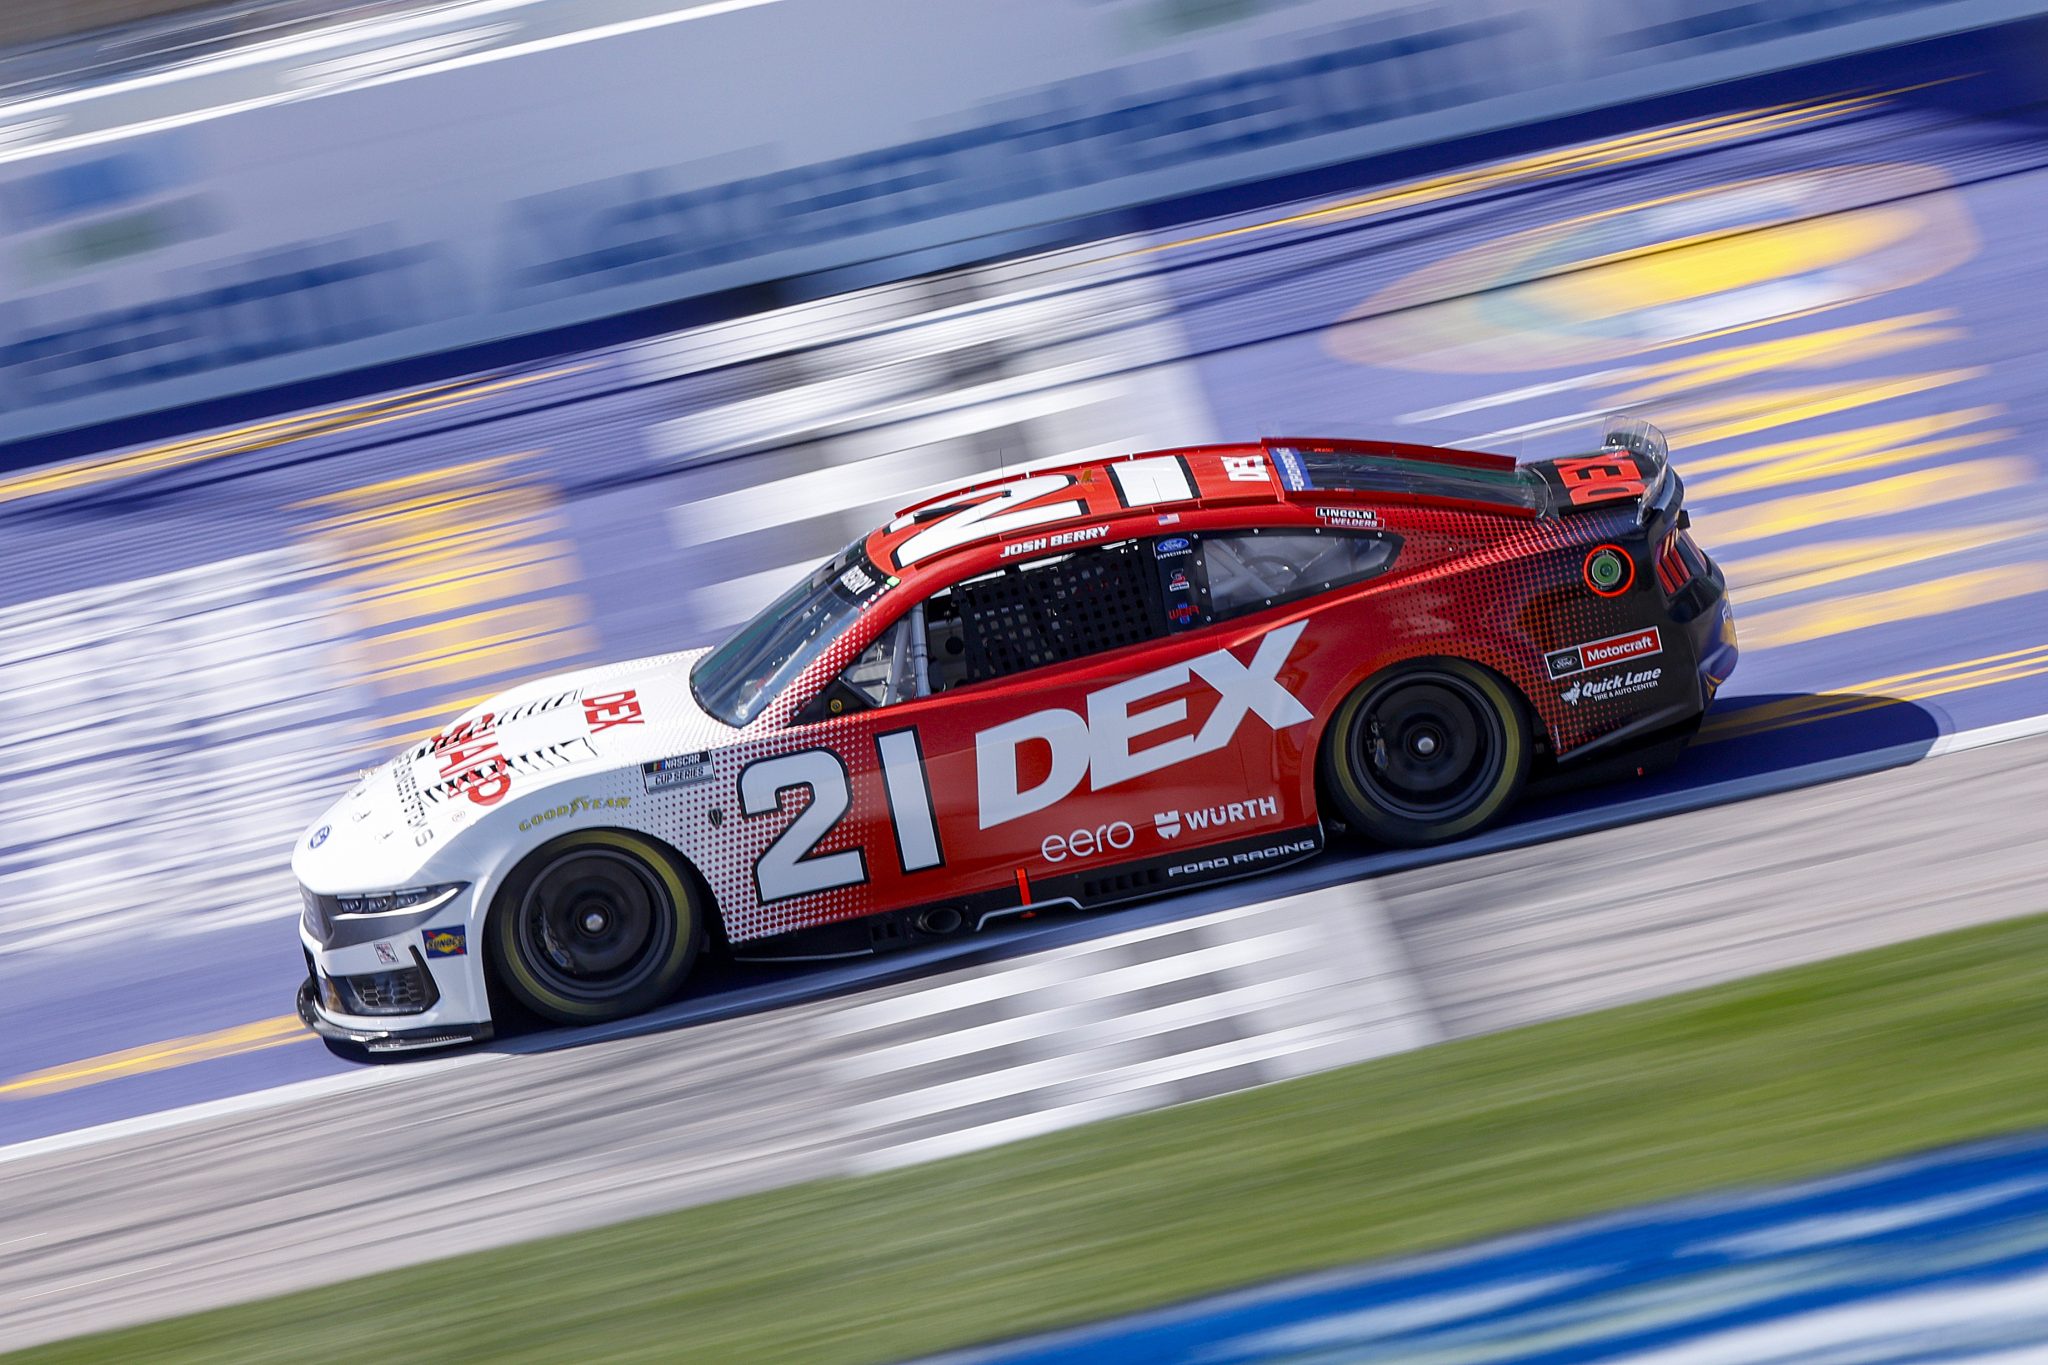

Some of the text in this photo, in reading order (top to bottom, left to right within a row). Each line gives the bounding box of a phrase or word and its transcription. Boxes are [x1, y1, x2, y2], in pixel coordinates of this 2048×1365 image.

[1552, 450, 1646, 505] DEX
[1319, 508, 1372, 519] LINCOLN
[1331, 517, 1378, 527] WELDERS
[999, 525, 1111, 558] JOSH BERRY
[840, 565, 876, 595] BERRY
[1586, 635, 1653, 662] Motorcraft
[1582, 667, 1662, 698] Quick Lane
[1594, 692, 1609, 702] TIRE
[1614, 687, 1633, 697] AUTO
[1632, 680, 1659, 692] CENTER
[581, 689, 645, 734] DEX
[975, 618, 1315, 830] DEX
[655, 766, 704, 785] CUP SERIES
[664, 752, 701, 770] NASCAR
[518, 794, 632, 832] GOODYEAR
[737, 725, 946, 906] 21
[1184, 796, 1278, 831] WÜRTH
[1041, 820, 1135, 862] eero
[1168, 839, 1315, 877] FORD RACING
